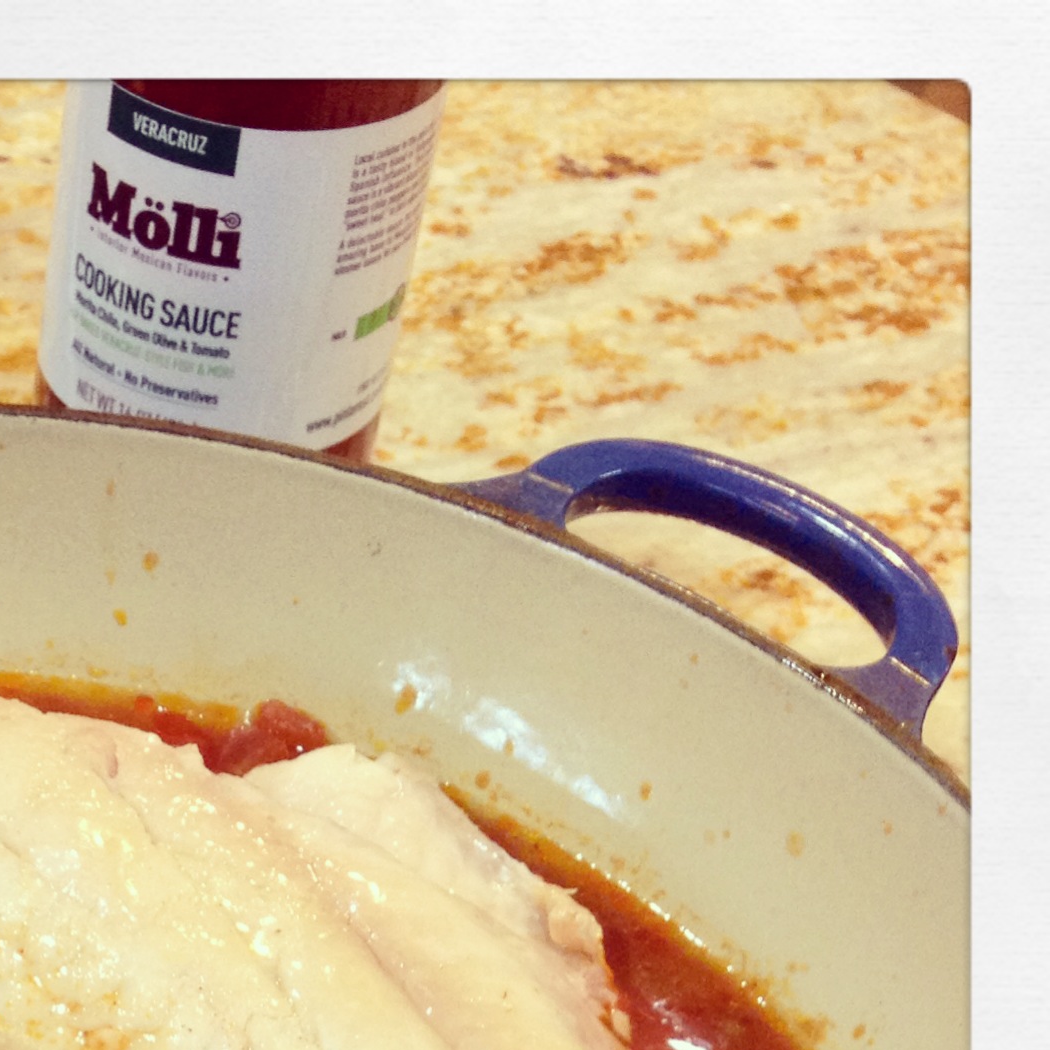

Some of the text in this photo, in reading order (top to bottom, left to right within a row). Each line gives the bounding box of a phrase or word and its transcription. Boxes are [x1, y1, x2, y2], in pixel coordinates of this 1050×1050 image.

[133, 111, 208, 155] VERACRUZ
[87, 160, 241, 269] Mölli
[130, 247, 173, 272] Mexican
[177, 261, 218, 283] Flavors
[75, 252, 156, 321] COOKING
[159, 299, 242, 340] SAUCE
[122, 320, 151, 343] Green
[151, 332, 179, 352] Olive
[179, 339, 189, 354] &
[191, 341, 231, 360] Tomato
[83, 347, 116, 376] Natural
[124, 369, 139, 387] No
[140, 374, 219, 406] Preservatives
